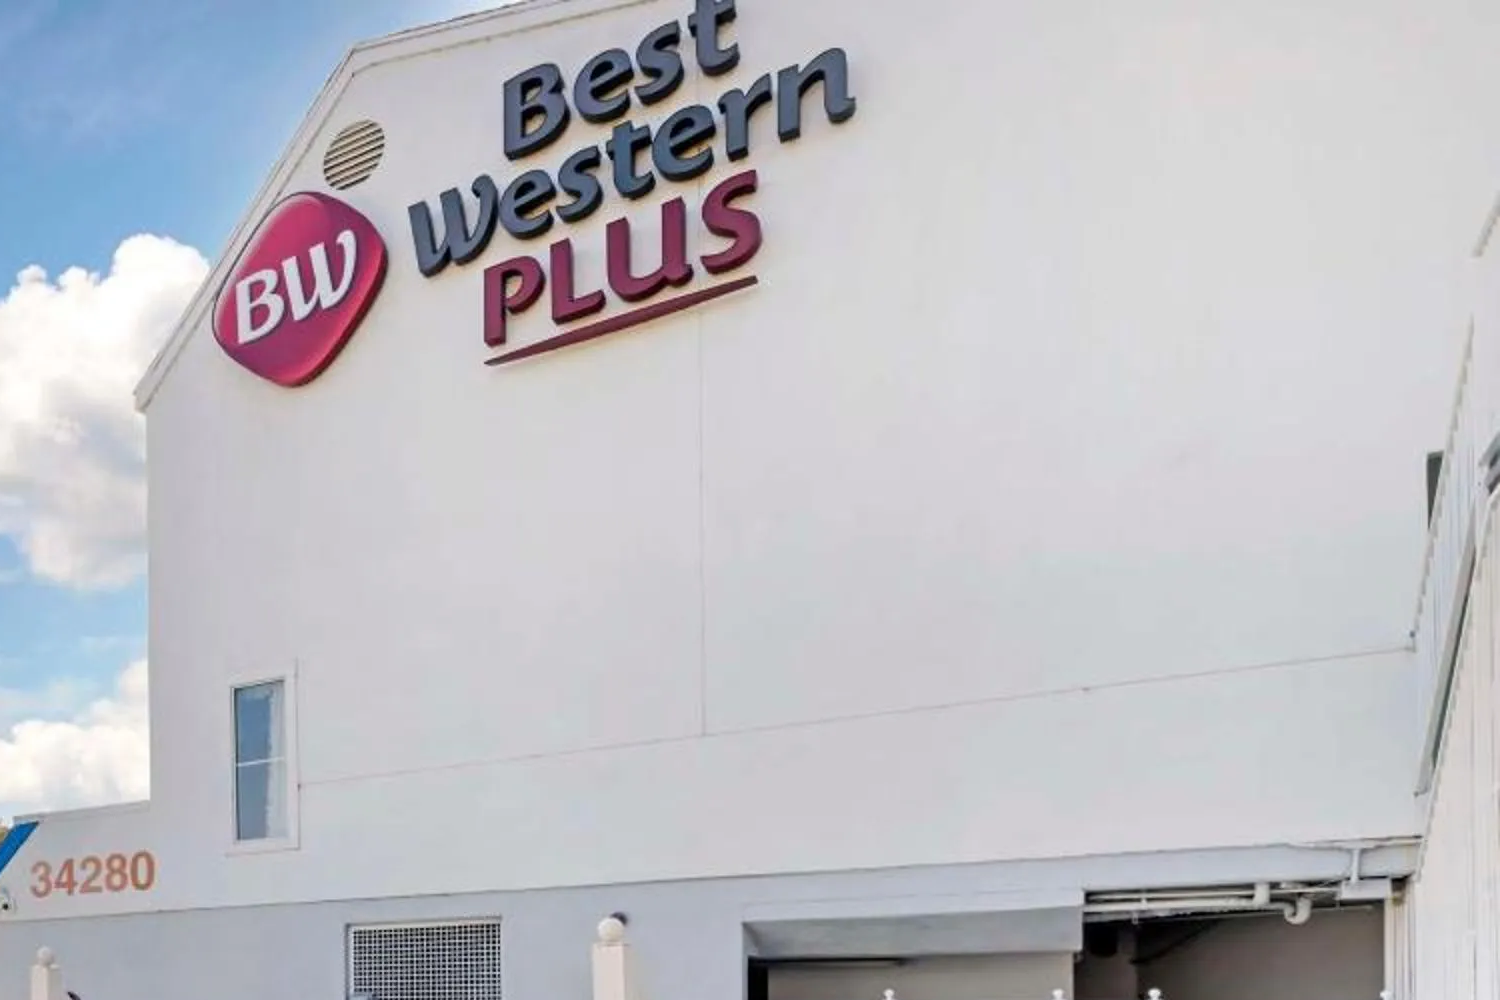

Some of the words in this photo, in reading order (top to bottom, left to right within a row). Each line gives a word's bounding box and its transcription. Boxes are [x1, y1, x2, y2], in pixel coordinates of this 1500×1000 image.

[503, 0, 742, 160] Best
[233, 228, 358, 345] BW
[484, 169, 763, 347] PLUS
[30, 850, 155, 898] 34280
